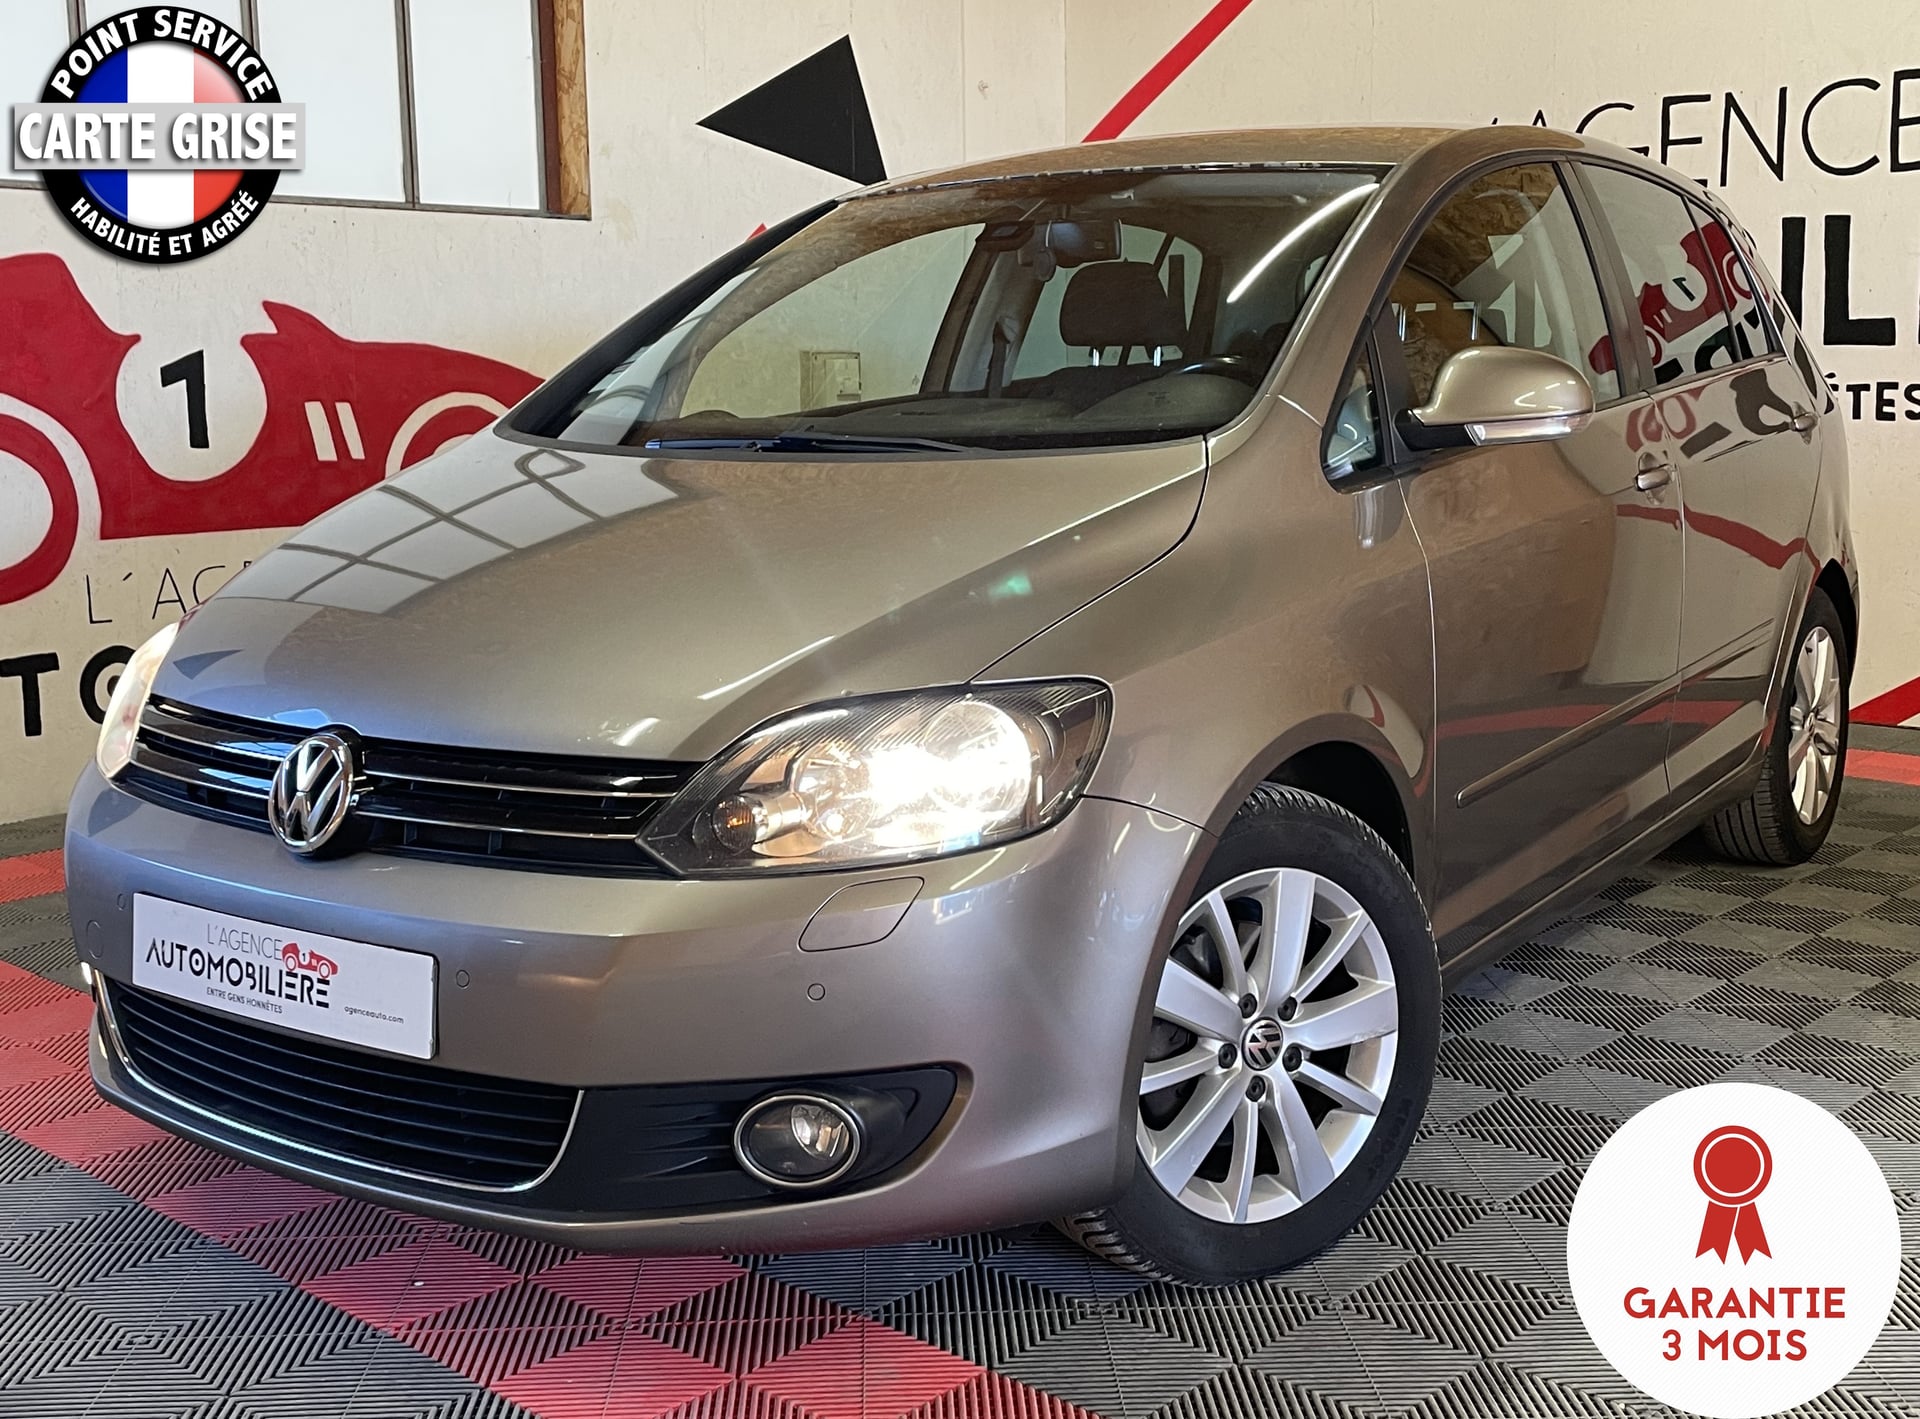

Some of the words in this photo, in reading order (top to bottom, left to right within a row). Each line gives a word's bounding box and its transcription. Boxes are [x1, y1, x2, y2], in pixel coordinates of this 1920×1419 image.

[160, 350, 209, 449] 1
[207, 923, 283, 961] L'AGENCE
[206, 987, 226, 1000] ENTRE
[228, 992, 245, 1005] GENS
[344, 1005, 405, 1024] agenceauto.com
